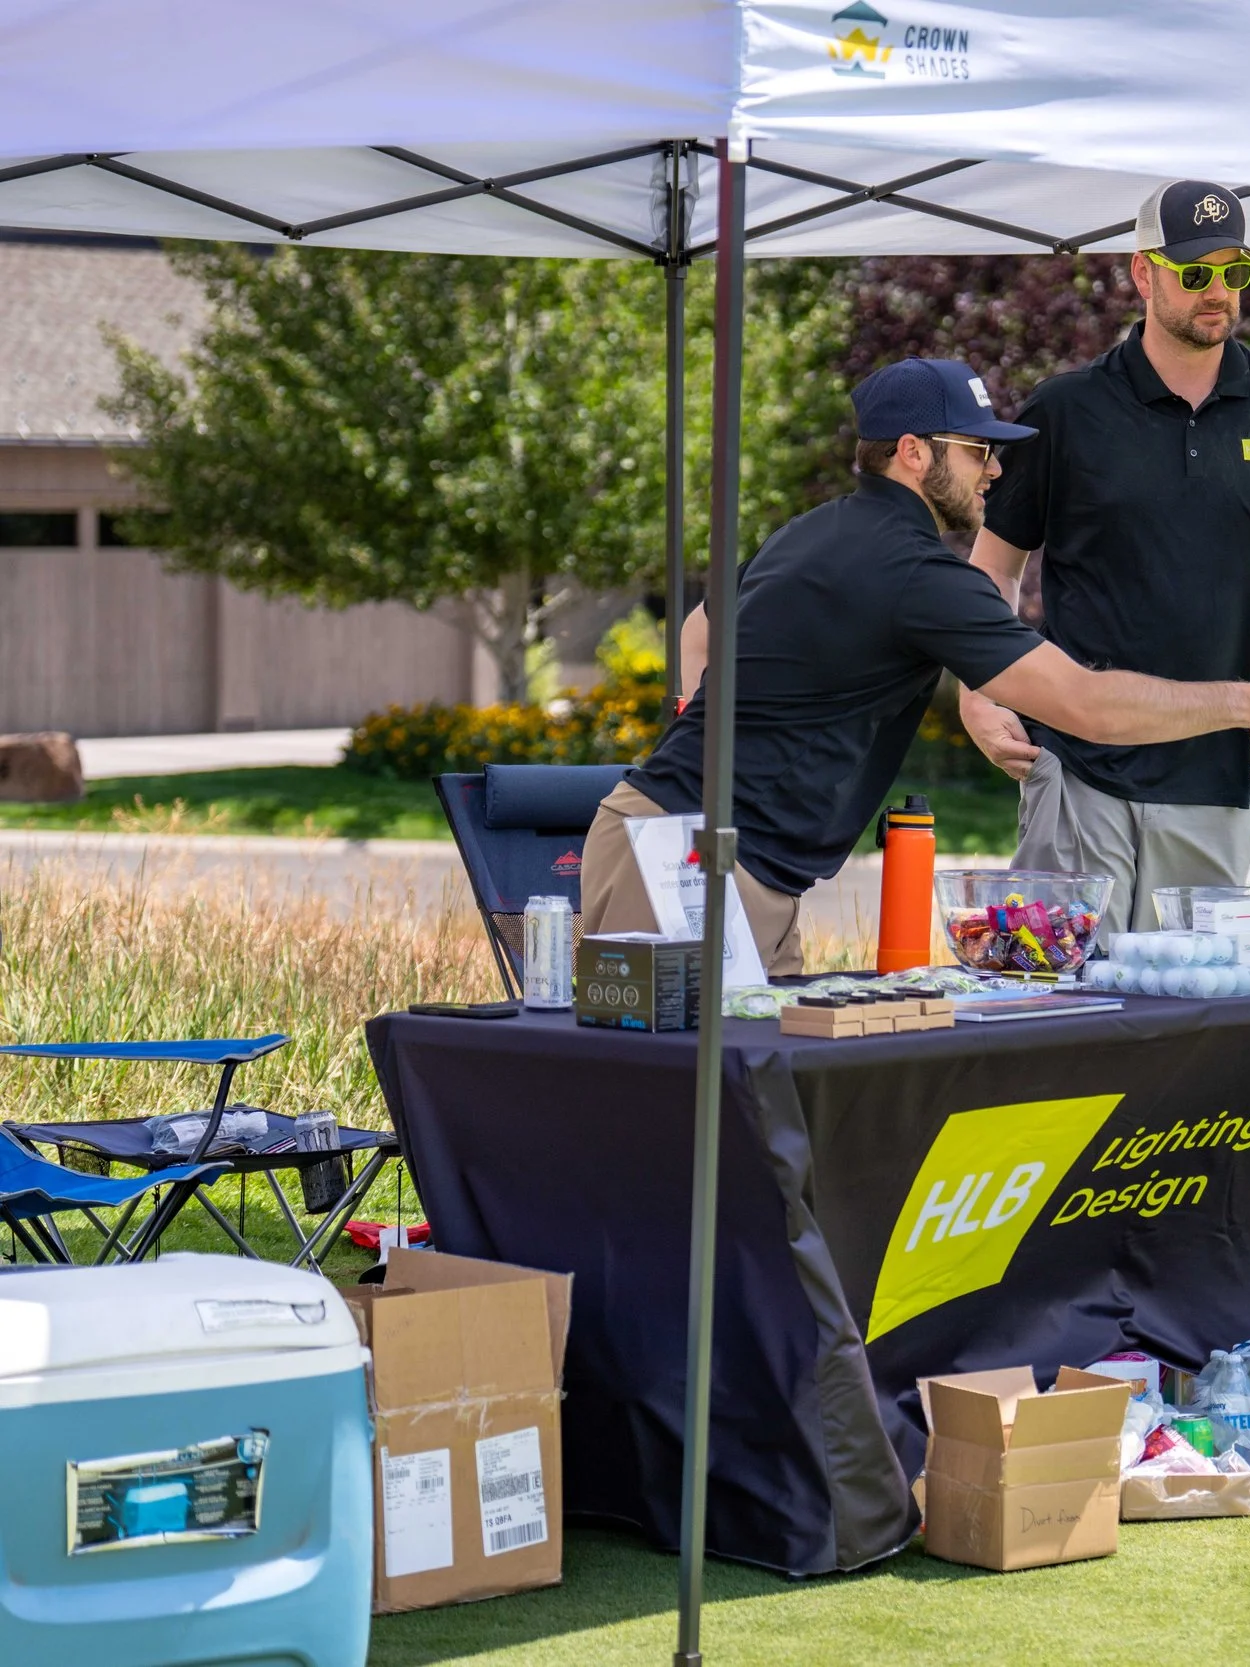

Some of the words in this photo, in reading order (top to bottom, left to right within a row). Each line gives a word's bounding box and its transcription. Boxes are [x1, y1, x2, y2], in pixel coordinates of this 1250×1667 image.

[904, 25, 969, 53] CROWN
[904, 55, 969, 80] SHADES
[1203, 197, 1221, 216] CU
[662, 860, 680, 872] Scan
[679, 879, 692, 888] our
[693, 876, 707, 887] dra
[905, 1160, 1046, 1253] HLB
[1049, 1169, 1208, 1226] Design
